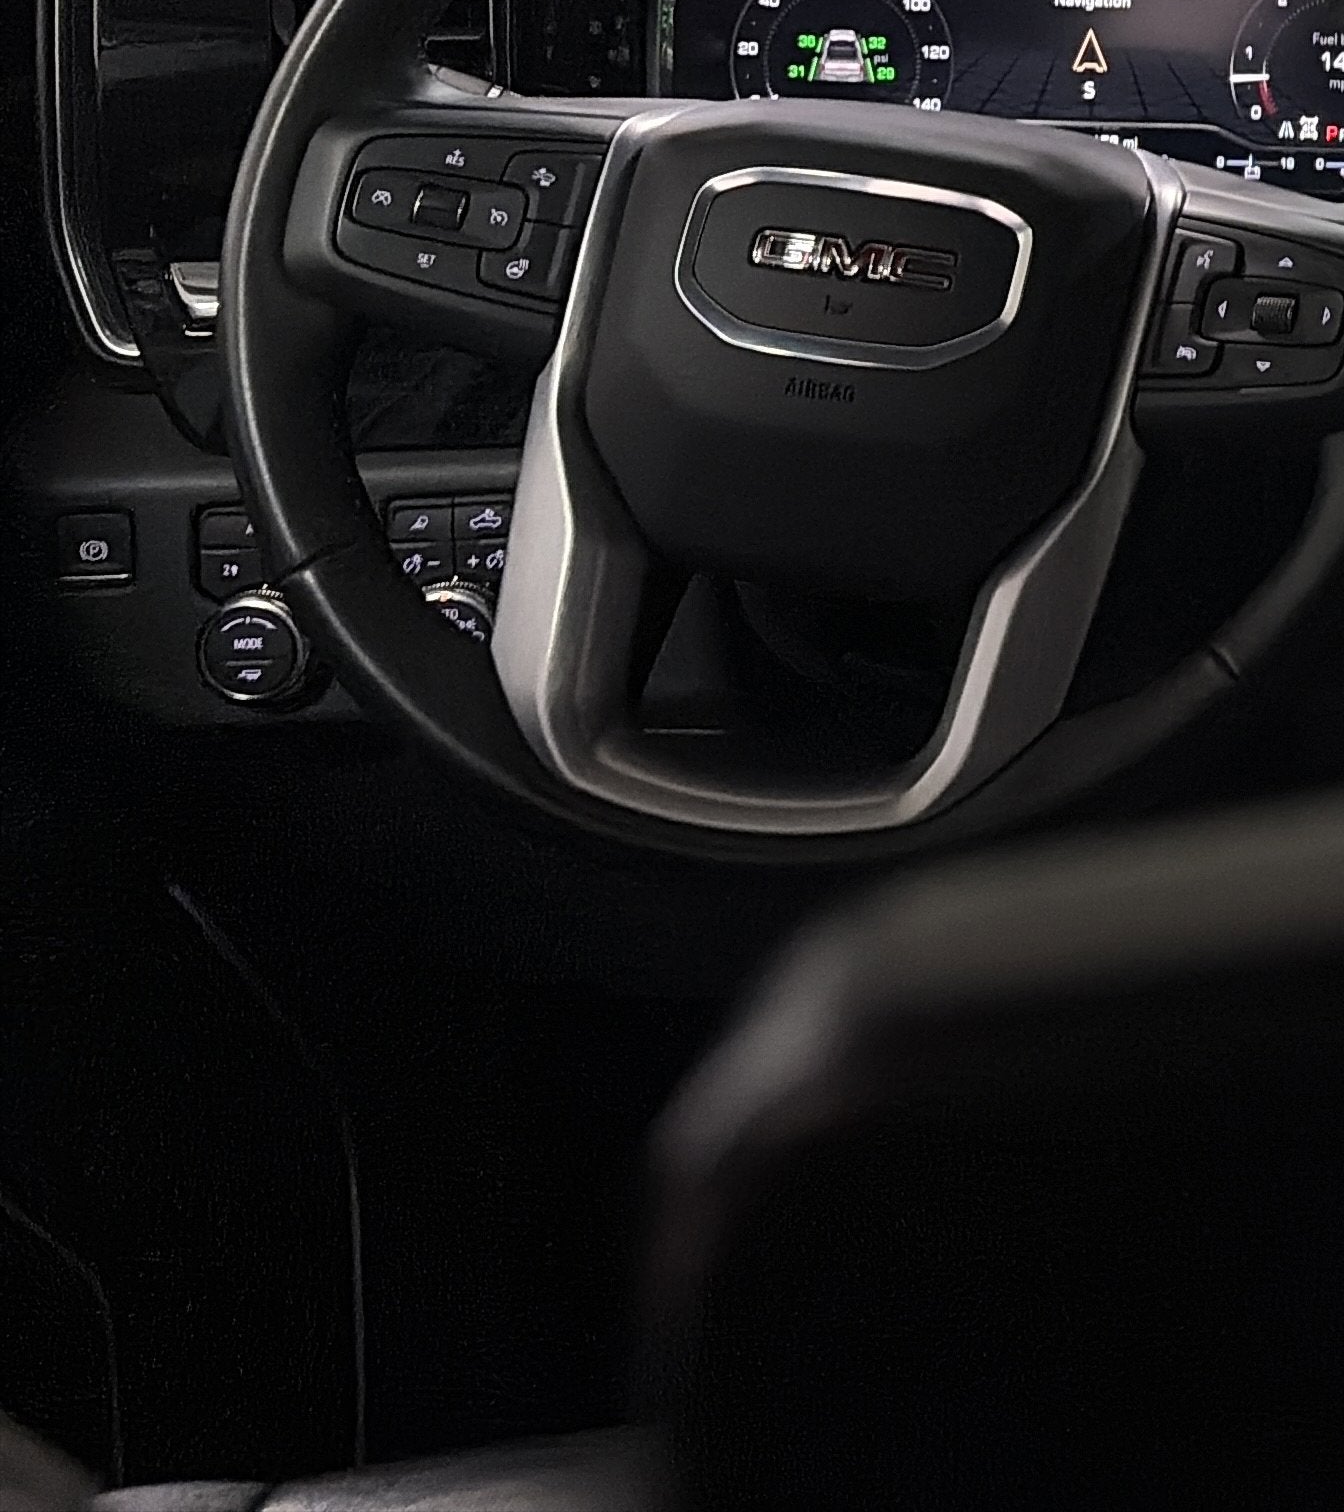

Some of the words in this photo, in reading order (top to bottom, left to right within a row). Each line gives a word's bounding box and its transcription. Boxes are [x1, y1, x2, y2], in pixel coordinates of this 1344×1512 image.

[868, 37, 886, 49] 32
[1312, 31, 1338, 47] Fuel
[737, 41, 758, 55] 20
[921, 45, 950, 60] 120
[1245, 45, 1253, 61] 1
[873, 53, 888, 66] psi
[787, 65, 804, 78] 31
[1082, 81, 1096, 100] S
[913, 96, 941, 112] 140
[417, 252, 437, 267] SET
[752, 229, 961, 291] GMC
[785, 376, 855, 403] AIRBAG
[233, 637, 264, 651] MODE
